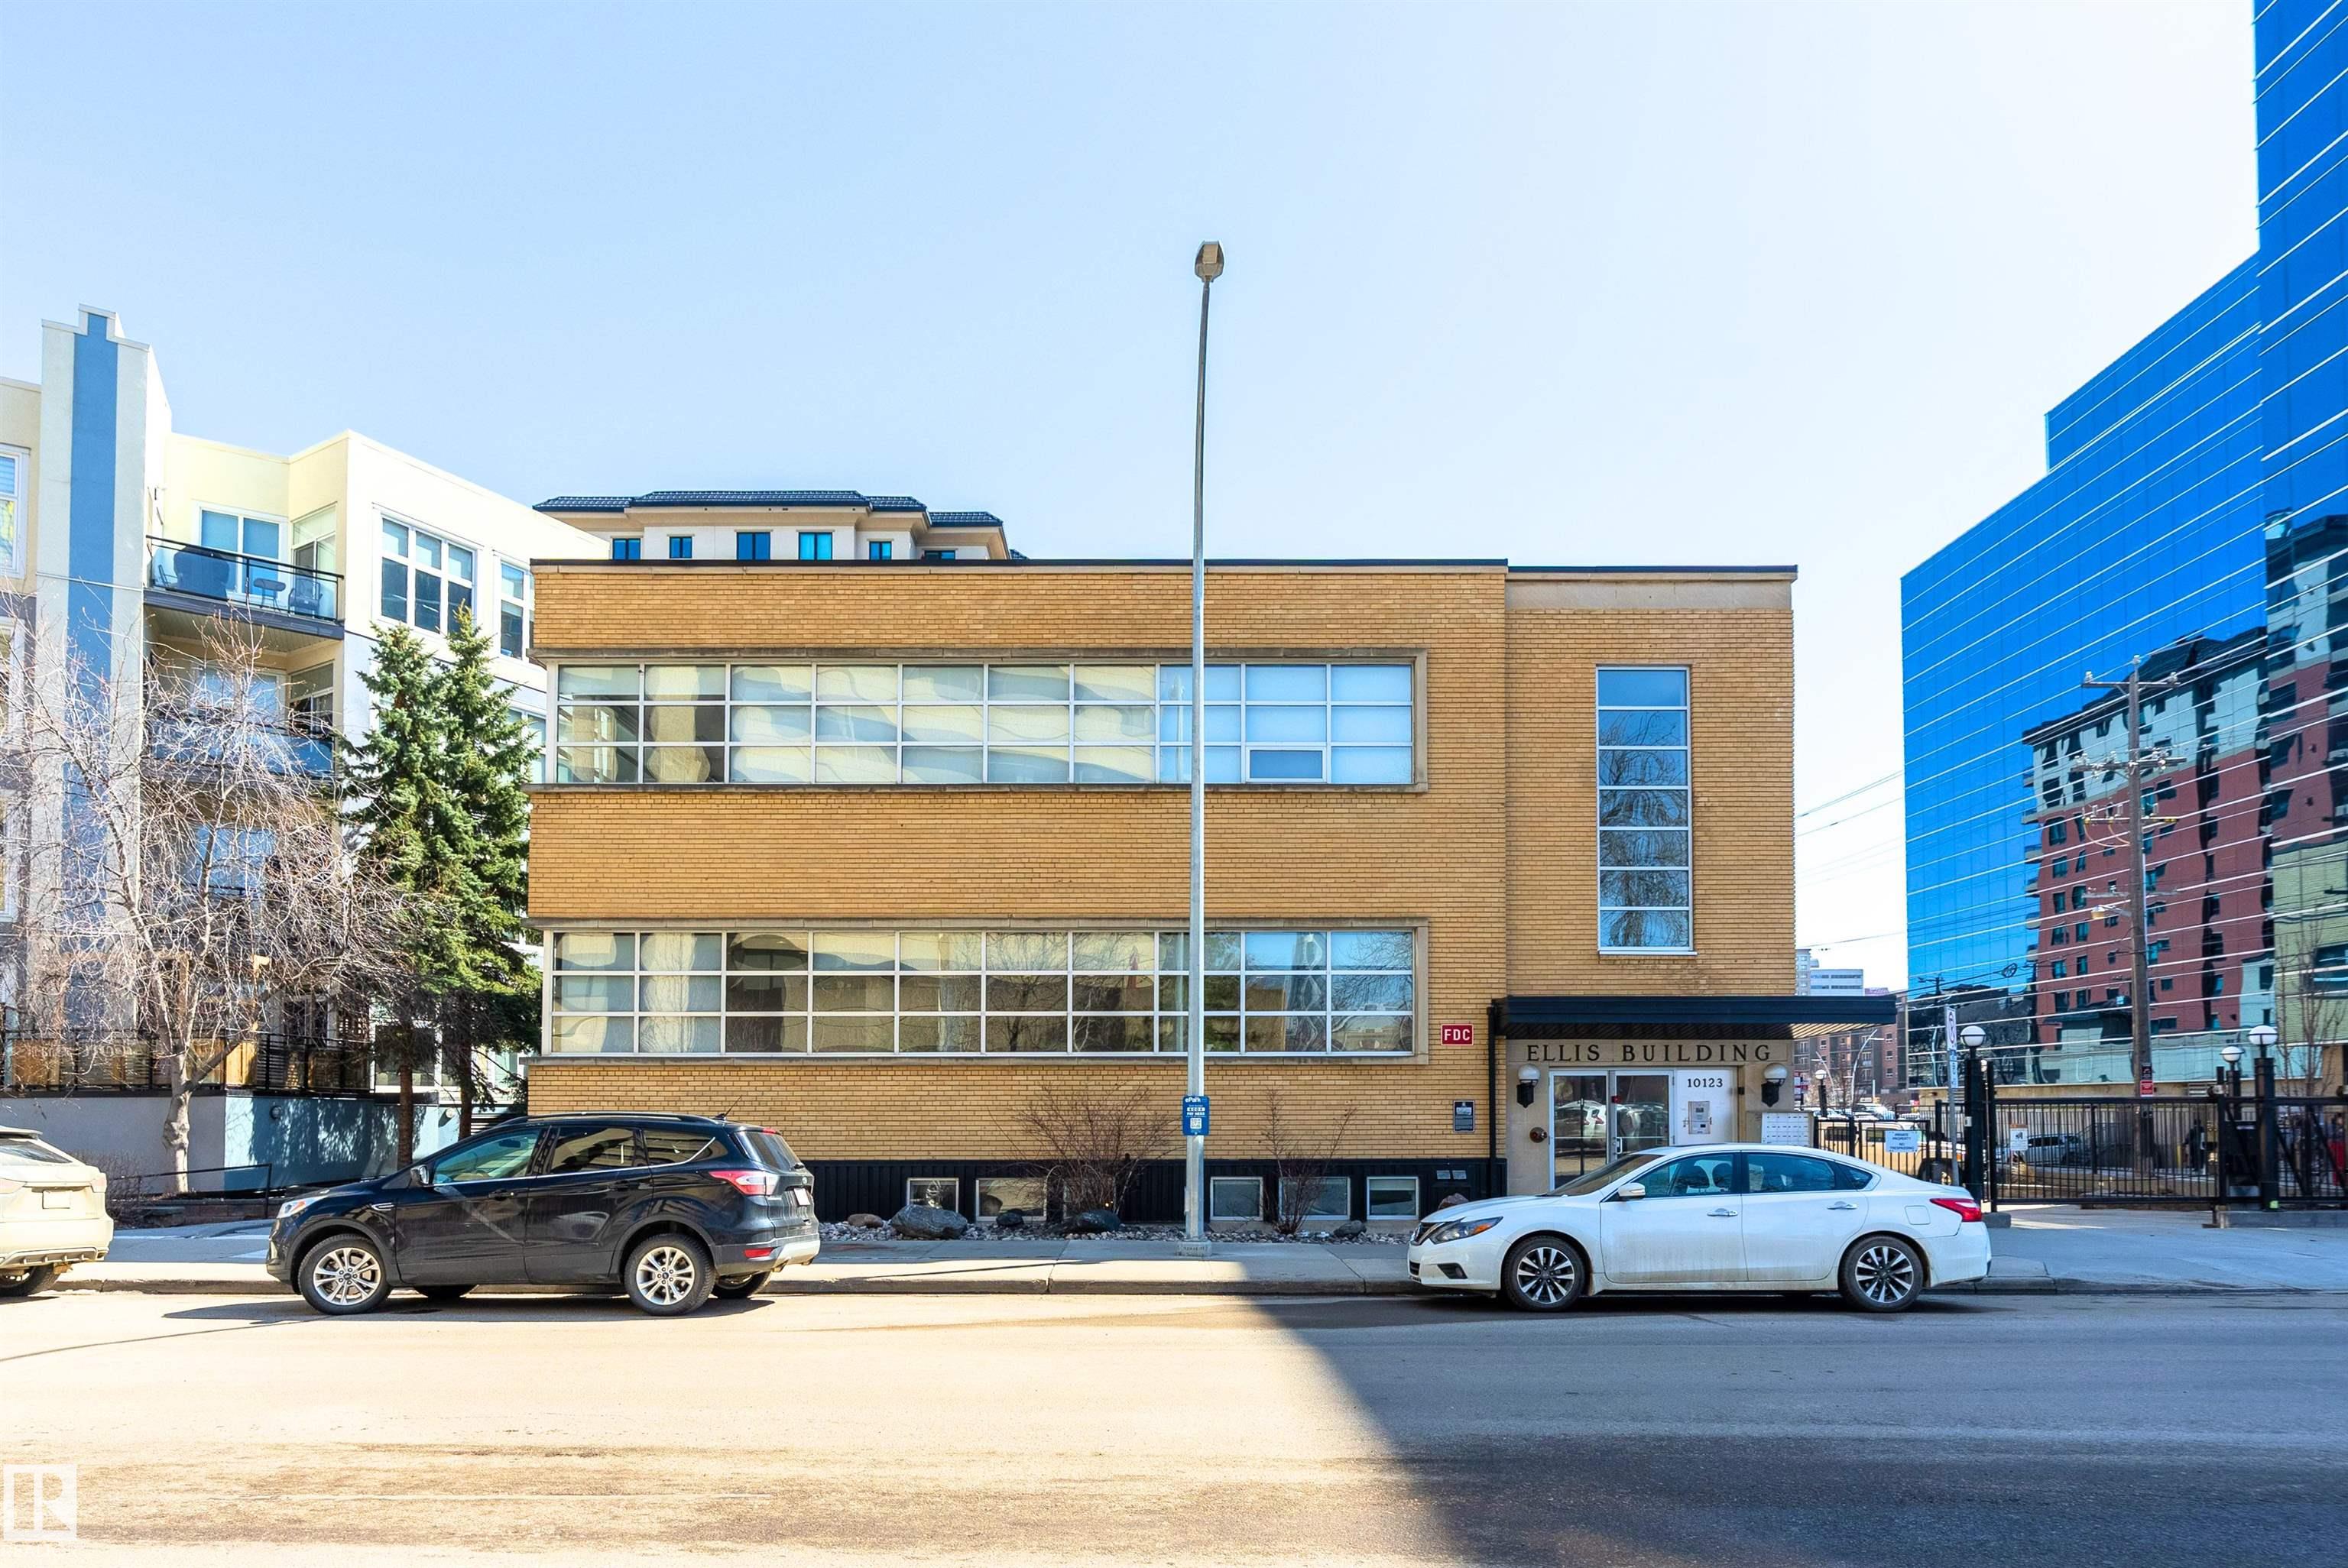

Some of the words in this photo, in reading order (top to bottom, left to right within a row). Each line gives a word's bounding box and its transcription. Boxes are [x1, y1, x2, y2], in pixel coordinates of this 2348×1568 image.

[1444, 1029, 1471, 1041] FDC
[1527, 1044, 1600, 1061] ELLIS
[1622, 1044, 1770, 1061] BUILDING
[1687, 1077, 1724, 1088] 10123
